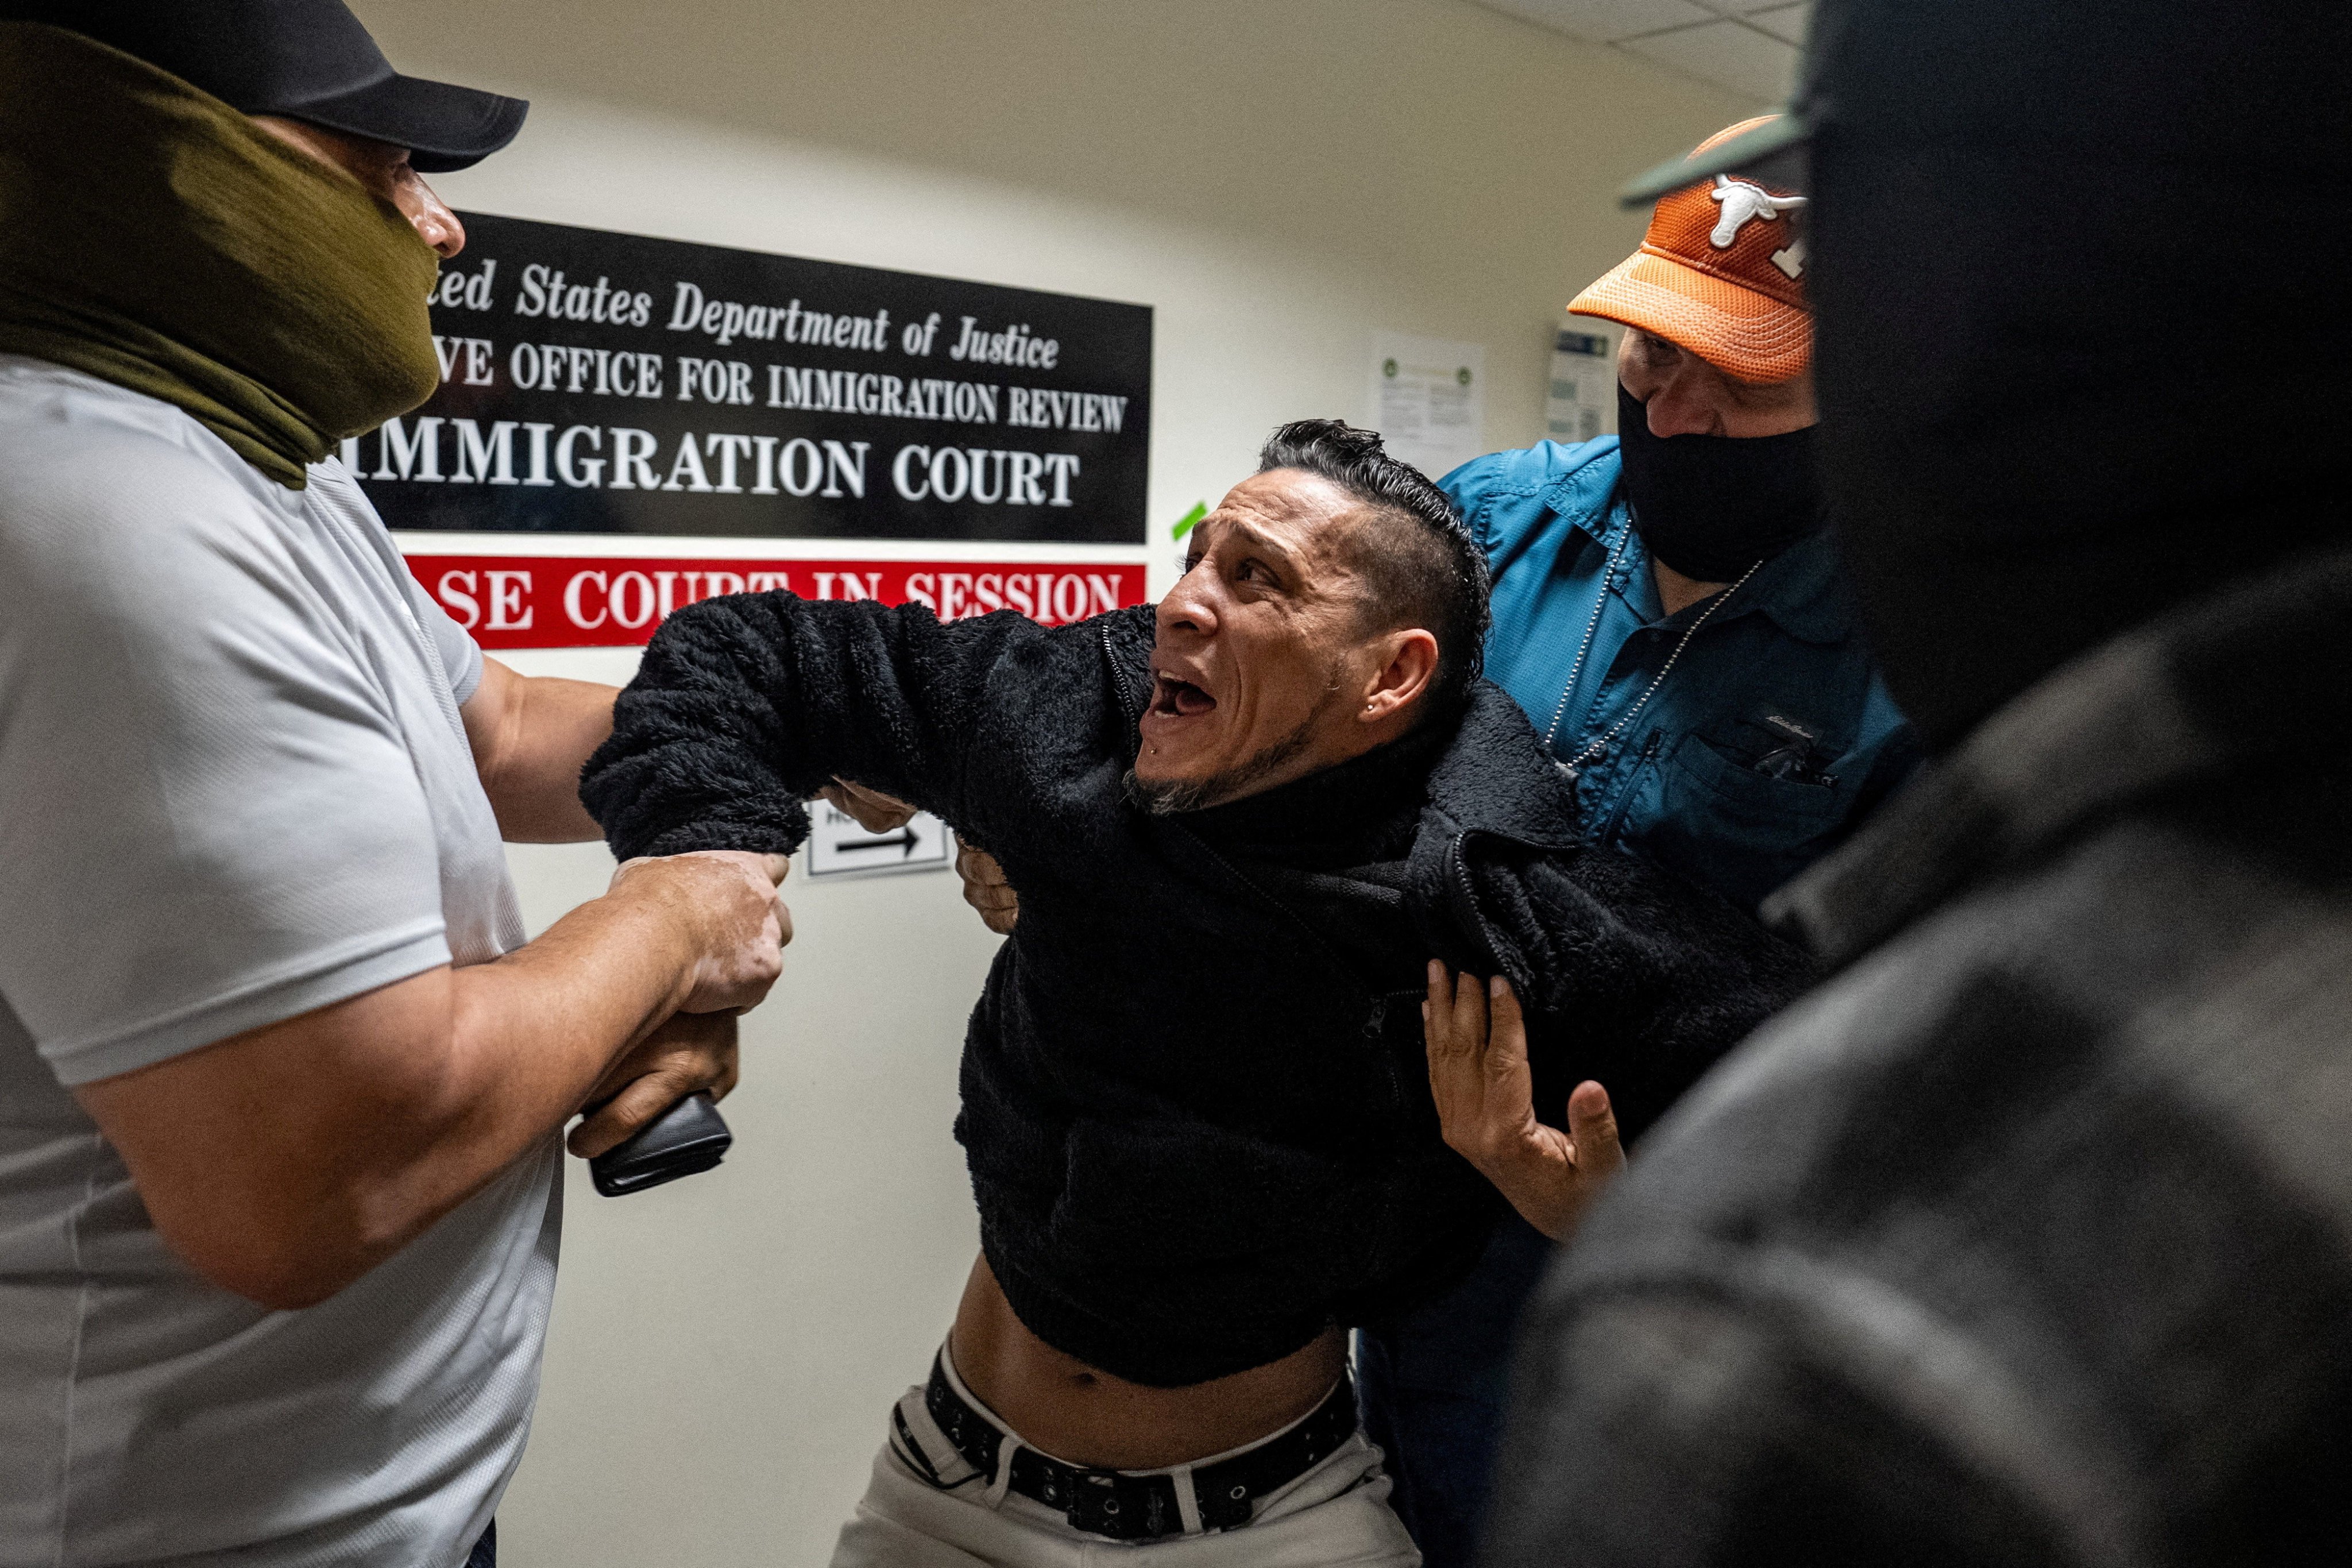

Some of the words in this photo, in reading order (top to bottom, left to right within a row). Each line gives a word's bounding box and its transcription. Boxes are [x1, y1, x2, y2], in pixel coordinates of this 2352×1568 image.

[516, 263, 652, 327] States
[667, 281, 890, 352] Department
[902, 312, 941, 357] of
[950, 315, 1060, 369] Justice
[510, 342, 663, 399] OFFICE
[678, 356, 754, 405] FOR
[767, 364, 999, 424] IMMIGRATION
[1009, 386, 1128, 432] REVIEW
[340, 416, 871, 499] IMMIGRATION
[893, 443, 1080, 507] COURT
[905, 572, 1123, 624] SESSION
